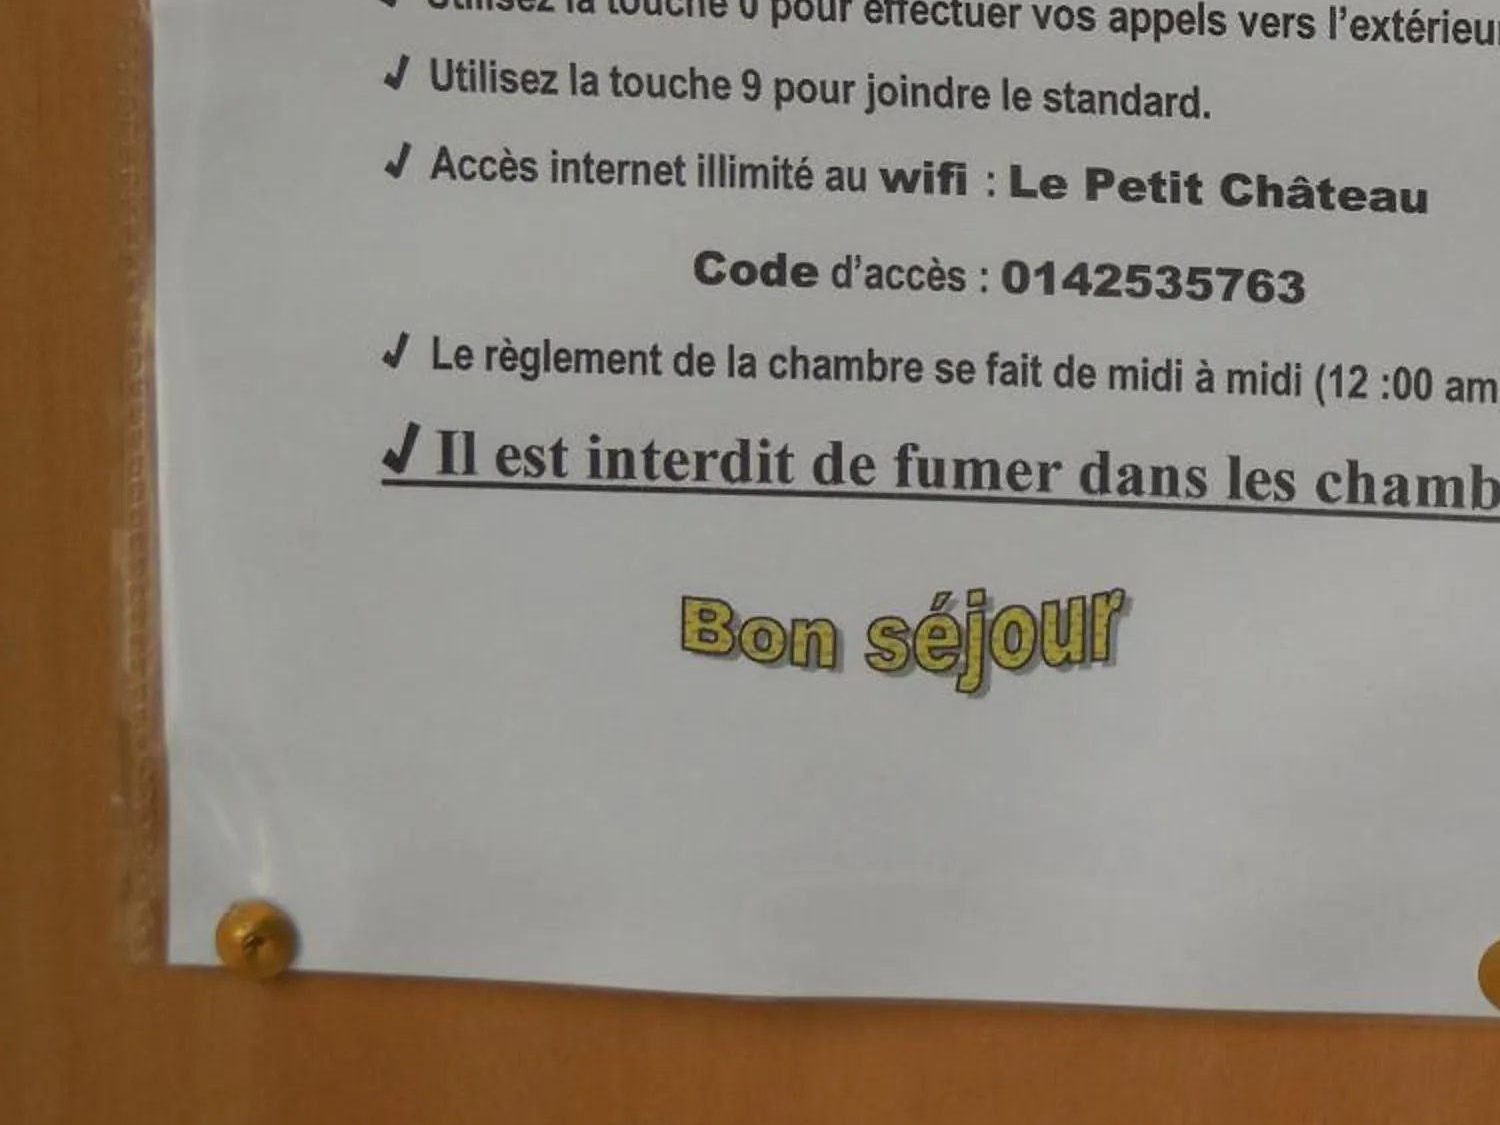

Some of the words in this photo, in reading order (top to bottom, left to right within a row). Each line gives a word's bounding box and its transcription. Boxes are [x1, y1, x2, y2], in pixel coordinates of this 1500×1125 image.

[1031, 4, 1096, 31] vos
[1108, 1, 1227, 43] appels
[1238, 11, 1316, 39] vers
[430, 57, 558, 95] Utilisez
[569, 62, 599, 97] la
[609, 65, 732, 100] touche
[742, 68, 762, 101] 9
[774, 77, 856, 111] pour
[864, 73, 991, 115] joindre
[1002, 77, 1032, 112] le
[1043, 81, 1210, 119] standard.
[430, 145, 538, 182] Accès
[551, 149, 686, 187] internet
[698, 153, 814, 191] illimité
[826, 166, 866, 192] au
[878, 160, 967, 195] wifi
[1010, 164, 1068, 200] Le
[1085, 167, 1203, 205] Petit
[1220, 173, 1428, 214] Château
[694, 250, 819, 288] Code
[1002, 260, 1305, 304] 0142535763
[432, 335, 474, 371] Le
[485, 337, 663, 382] règlement
[673, 342, 716, 378] de
[728, 344, 756, 379] la
[768, 345, 924, 383] chambre
[935, 358, 976, 385] se
[985, 351, 1042, 387] fait
[1053, 354, 1096, 390] de
[1108, 357, 1182, 393] midi
[1195, 359, 1215, 393] à
[1227, 360, 1302, 397] midi
[1315, 363, 1368, 407] (12
[1382, 366, 1433, 401] :00
[437, 430, 478, 475] Il
[495, 437, 569, 480] est
[586, 433, 796, 487] interdit
[811, 441, 878, 489] de
[893, 443, 1062, 494] fumer
[1079, 452, 1208, 500] dans
[1226, 455, 1297, 504] les
[680, 595, 838, 670] Bon
[864, 587, 1126, 695] séjour
